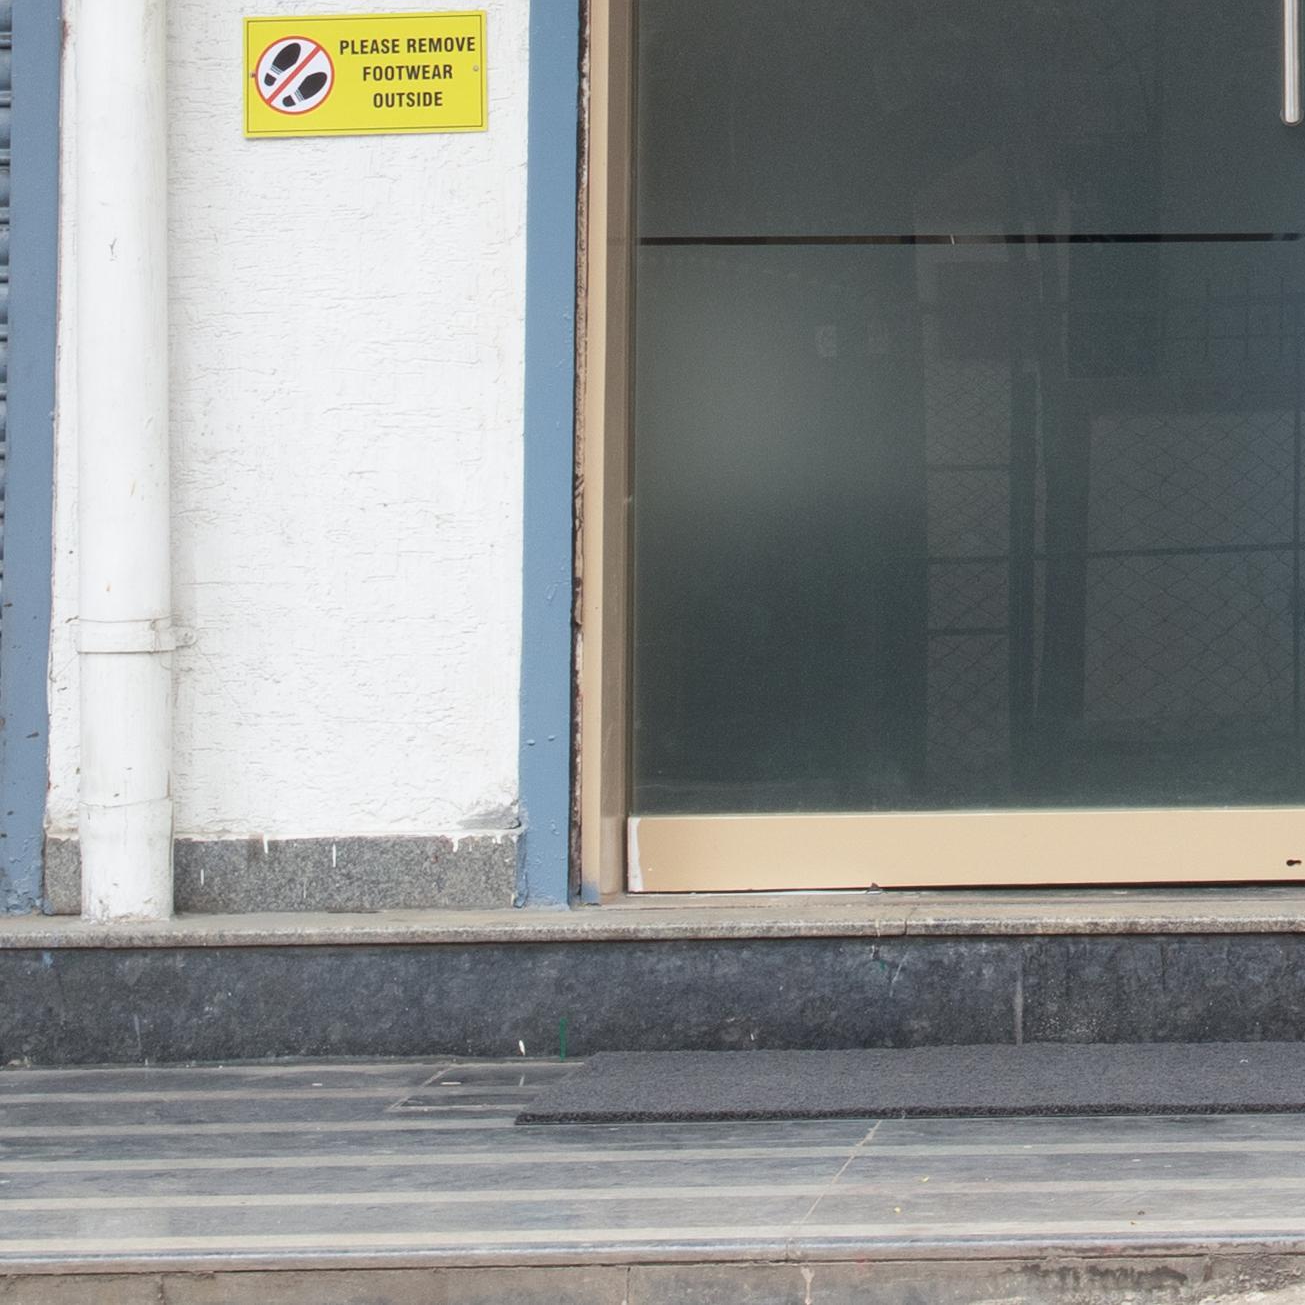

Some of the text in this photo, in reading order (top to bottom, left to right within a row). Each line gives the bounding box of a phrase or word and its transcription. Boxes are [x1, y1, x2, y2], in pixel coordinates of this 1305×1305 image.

[340, 37, 475, 55] PLEASE REMOVE
[363, 65, 452, 81] FOOTWEAR
[374, 92, 442, 108] OUTSIDE
